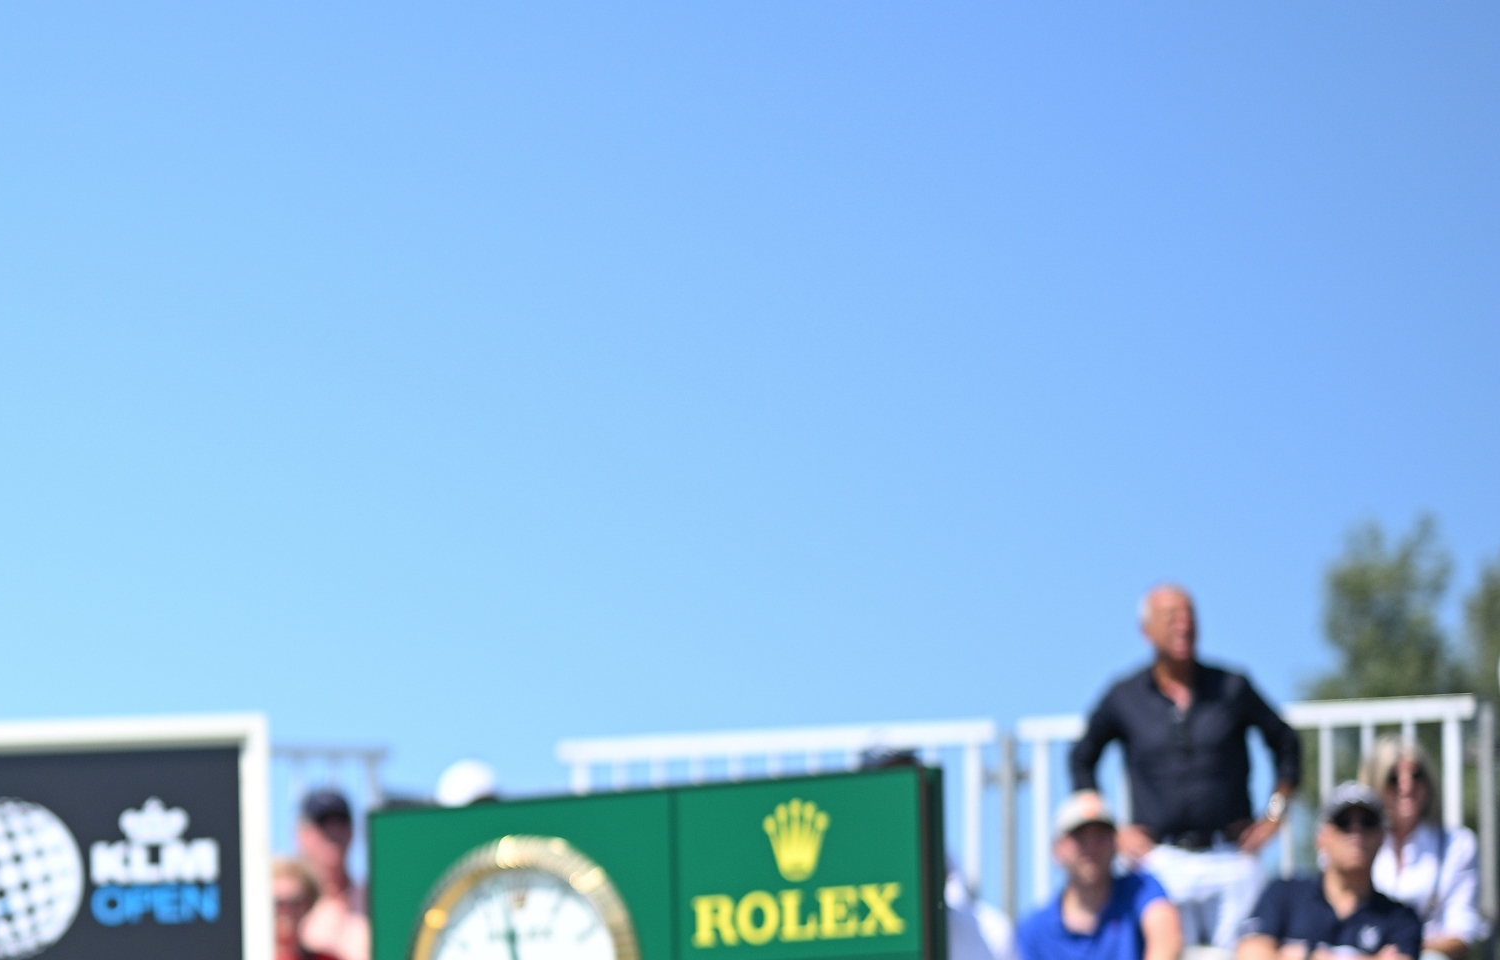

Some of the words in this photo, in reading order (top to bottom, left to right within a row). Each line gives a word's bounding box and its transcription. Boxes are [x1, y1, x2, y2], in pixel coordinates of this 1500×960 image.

[89, 838, 221, 886] KLM
[90, 882, 222, 927] OPEN
[691, 881, 906, 949] ROLEX
